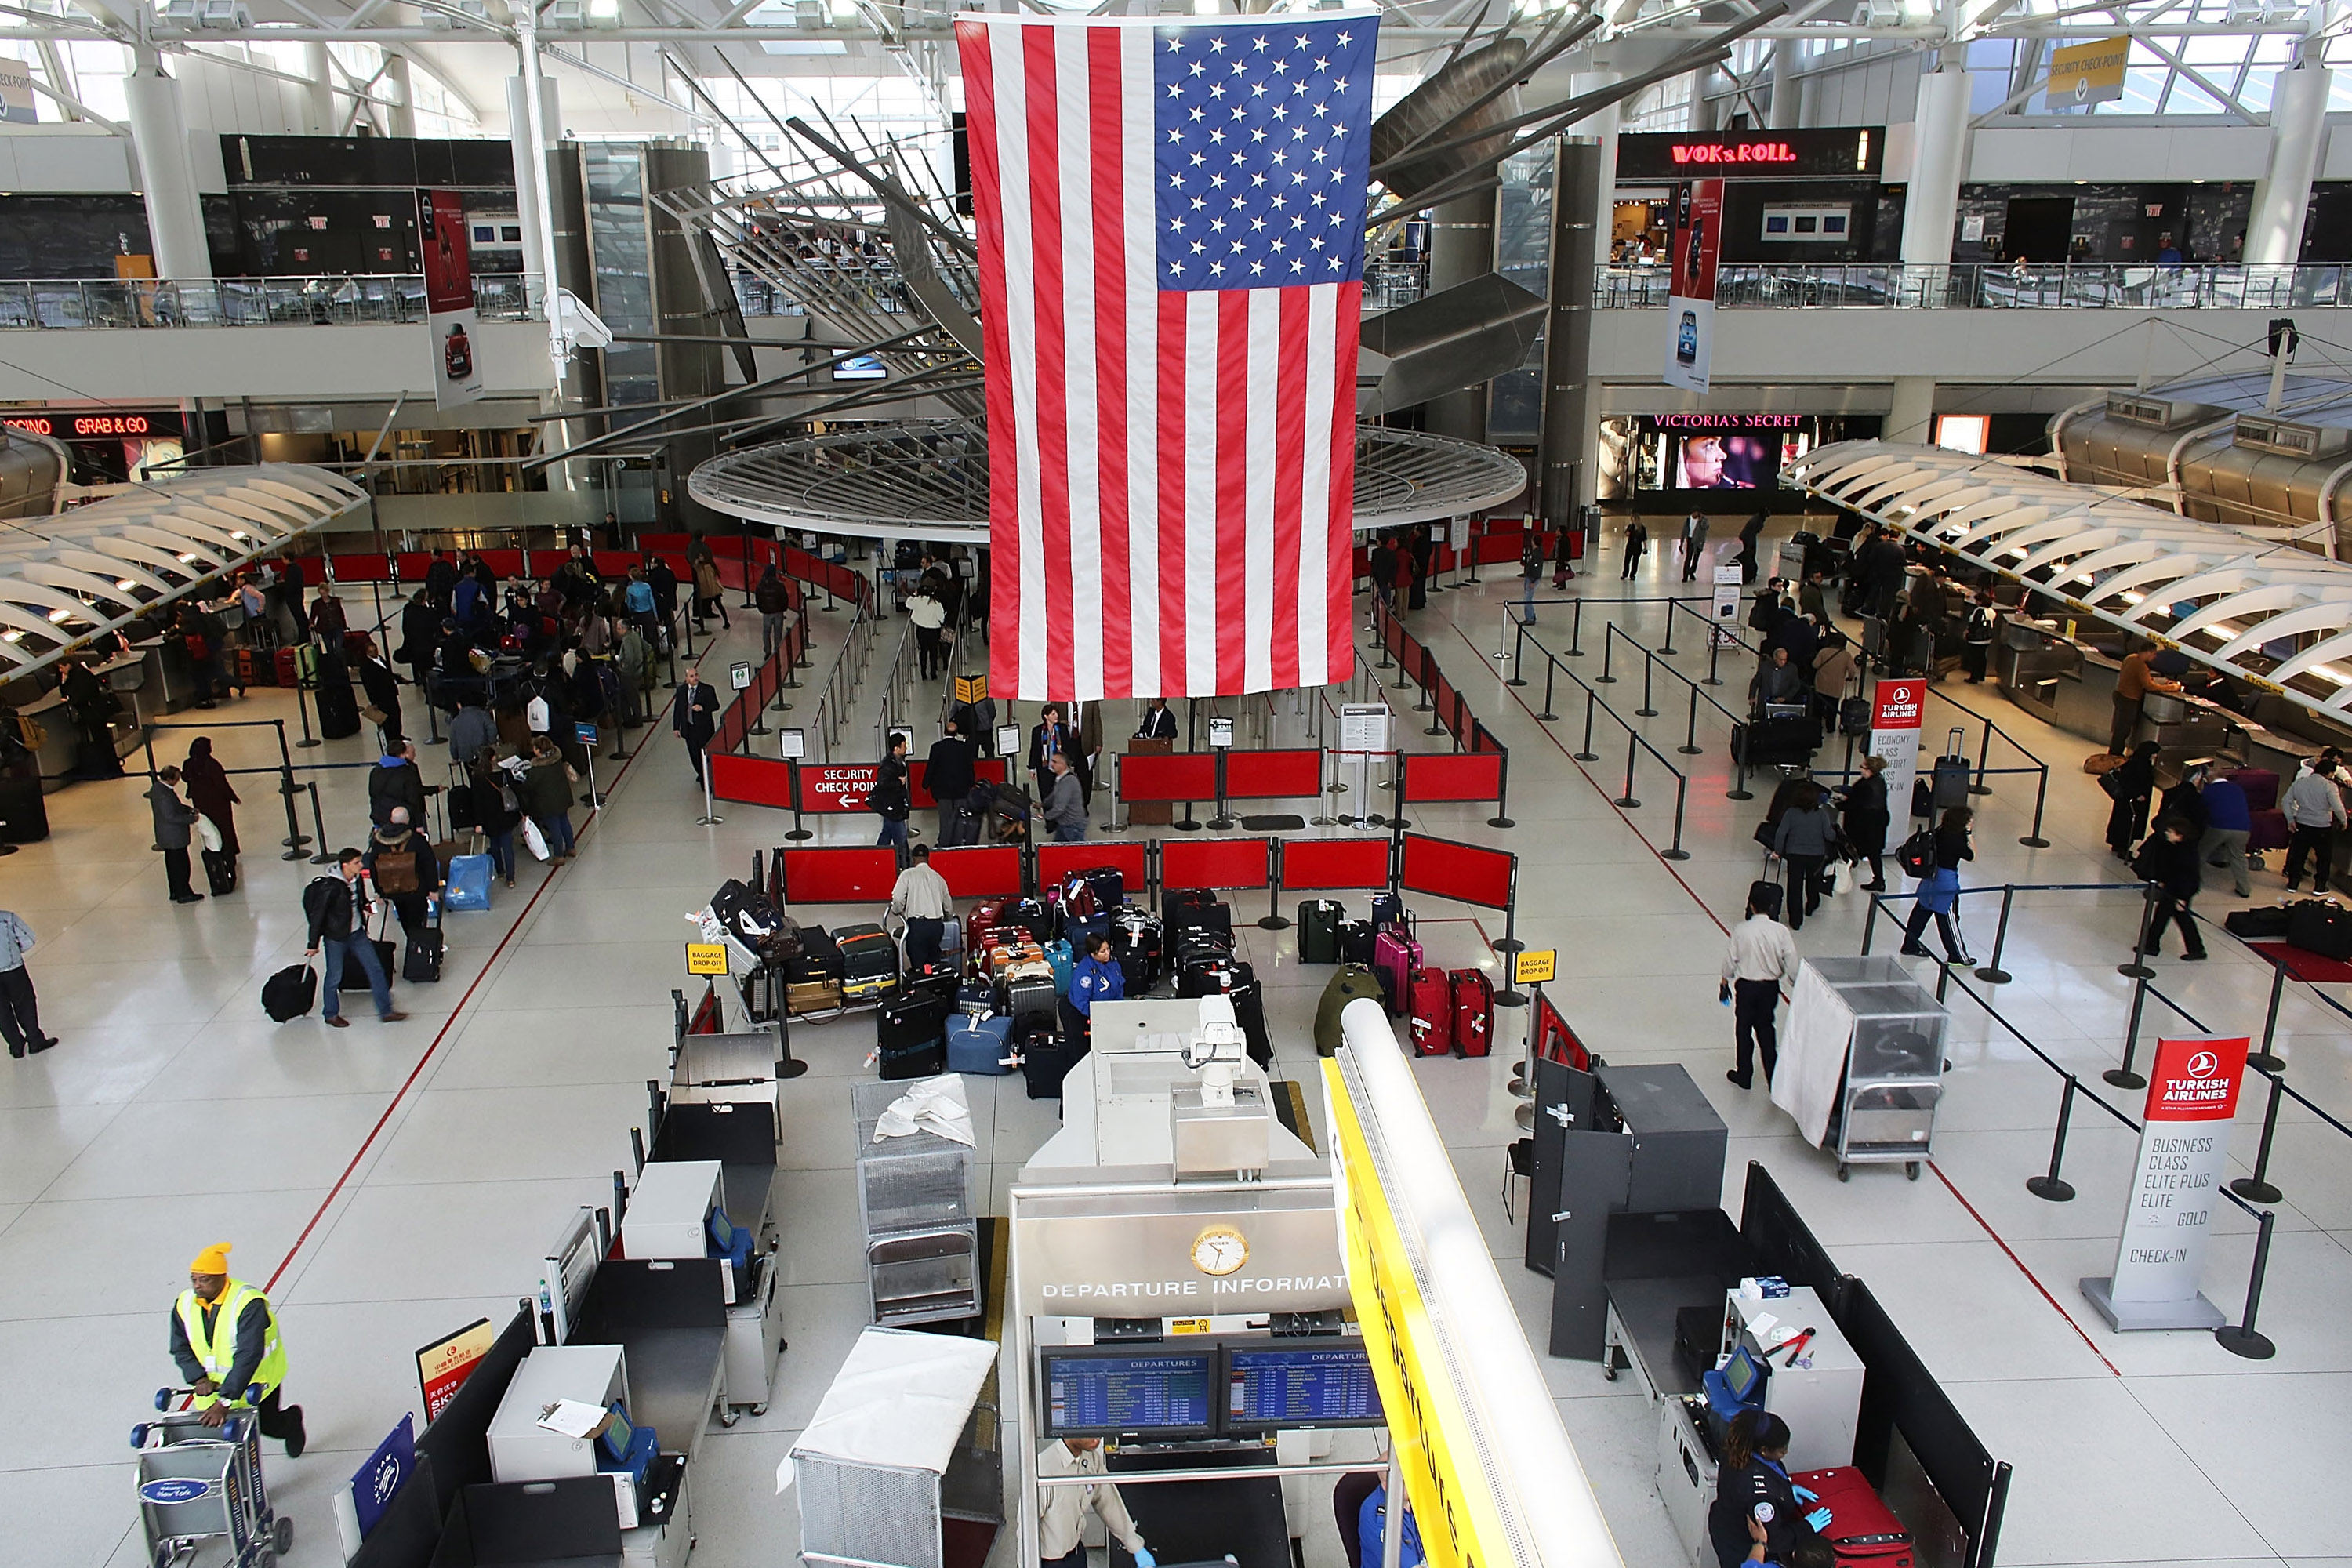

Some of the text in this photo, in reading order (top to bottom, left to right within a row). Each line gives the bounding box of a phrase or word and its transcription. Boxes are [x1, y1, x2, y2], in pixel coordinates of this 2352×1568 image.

[2051, 53, 2125, 77] SECURITY CHECK-POINT
[75, 416, 147, 434] GRAB & GO
[1654, 414, 1802, 426] VICTORIA'S SECRET
[1881, 710, 1917, 718] AIRLINES
[1878, 735, 1911, 745] ECONOMY
[824, 769, 873, 780] SECURITY
[815, 782, 877, 793] CHECK POIN
[2166, 1078, 2230, 1090] TURKISH
[2162, 1089, 2227, 1101] AIRLINES
[2152, 1138, 2212, 1153] BUSINESS
[2149, 1156, 2189, 1170] CLASS
[2144, 1174, 2210, 1189] ELITE PLUS
[2141, 1194, 2173, 1207] ELITE
[2177, 1210, 2208, 1226] GOLD
[2130, 1249, 2187, 1264] CHECK-IN
[1042, 1275, 1346, 1298] DEPARTURE INFORMAT
[435, 1366, 450, 1375] CHINA
[1368, 1239, 1460, 1558] Departure
[228, 1477, 243, 1539] smartecarte
